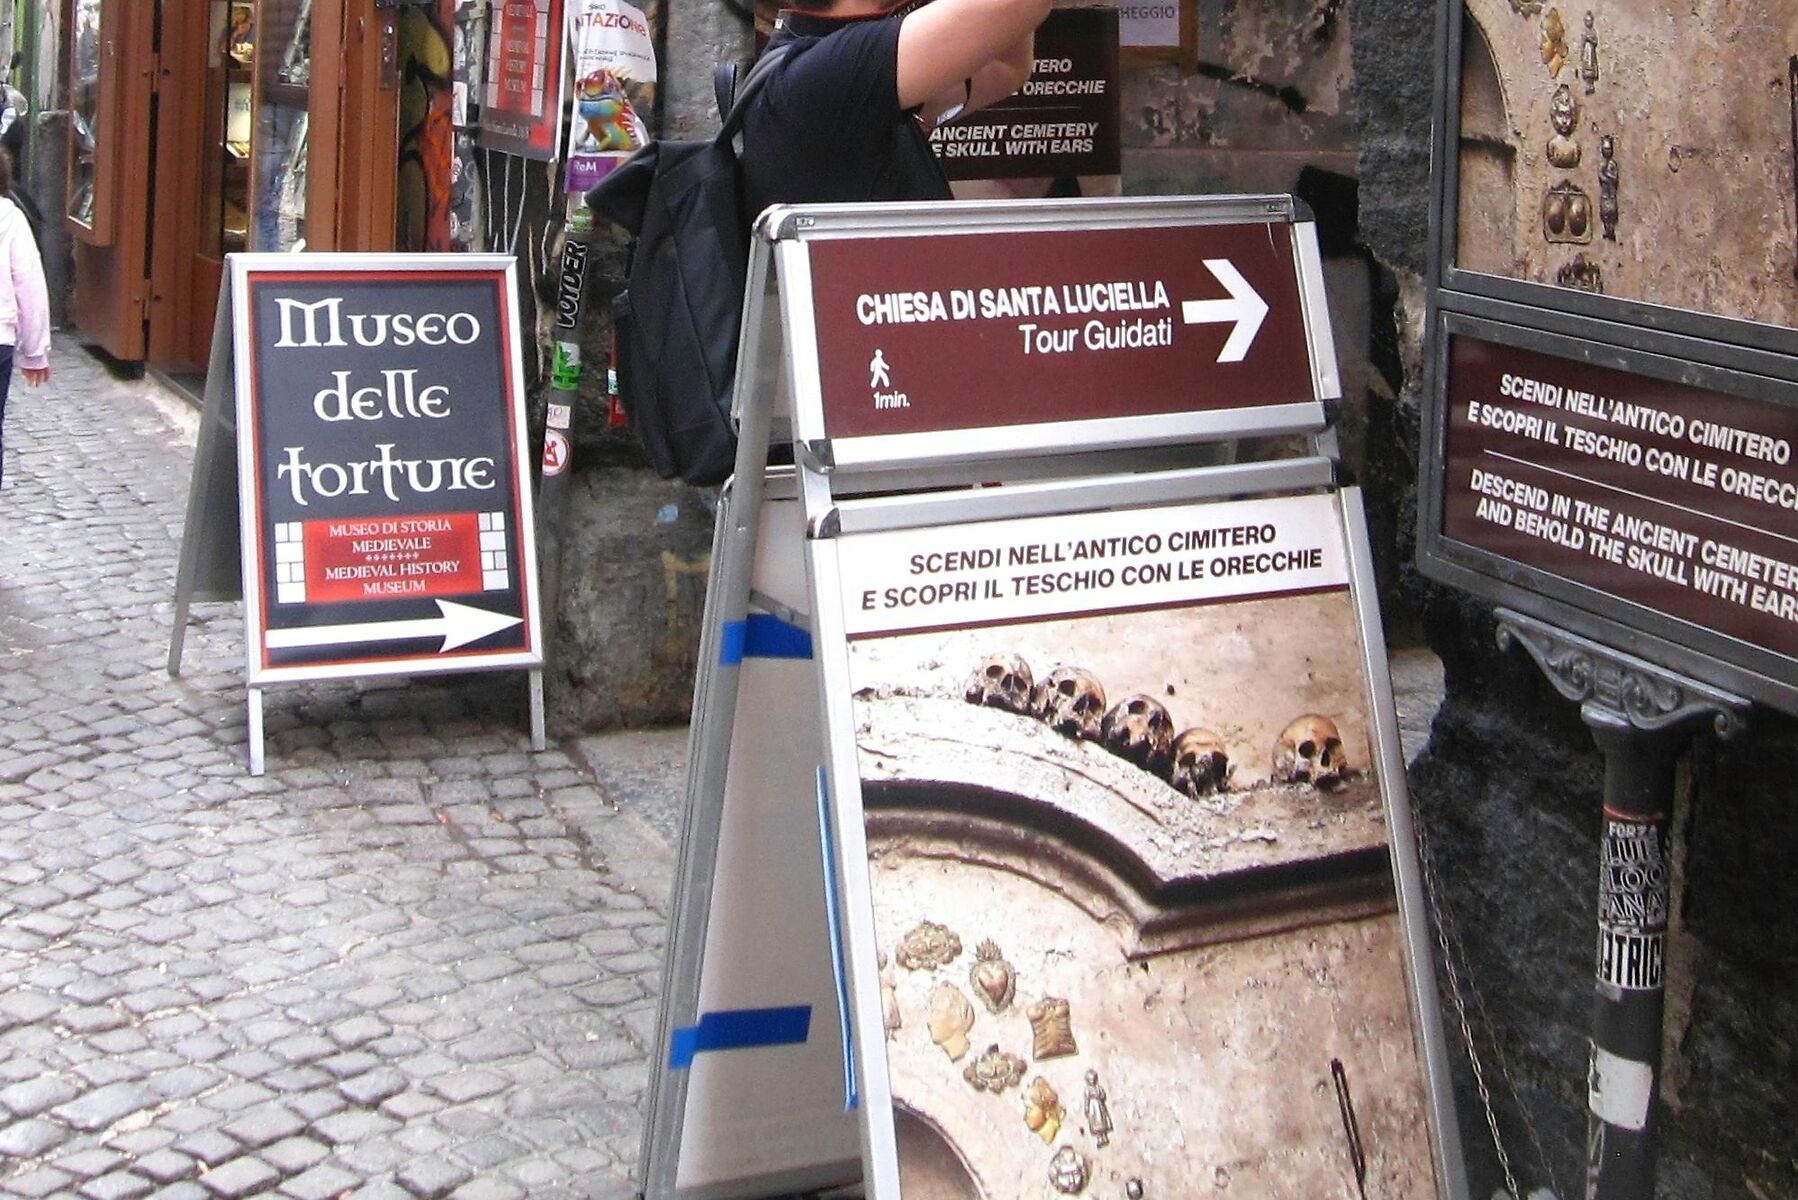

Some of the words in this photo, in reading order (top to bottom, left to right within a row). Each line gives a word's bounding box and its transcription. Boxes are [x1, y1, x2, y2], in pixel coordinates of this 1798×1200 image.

[1023, 80, 1106, 96] ORECCHIE
[928, 125, 1008, 142] ANCIENT
[1010, 122, 1099, 139] CEMETERY
[945, 141, 1000, 158] SKULL
[1005, 140, 1048, 156] WITH
[1050, 138, 1094, 154] EARS
[857, 291, 948, 326] CHIESA
[953, 289, 977, 319] DI
[981, 285, 1060, 319] SANTA
[1063, 280, 1170, 313] LUCIELLA
[1019, 323, 1078, 354] Tour
[1083, 316, 1172, 352] Guidati
[1500, 373, 1562, 407] SCENDI
[1565, 387, 1685, 440] NELL'ANTICO
[1688, 419, 1792, 466] CIMITERO
[1468, 400, 1479, 422] E
[1480, 403, 1542, 440] SCOPRI
[1544, 421, 1559, 445] IL
[1563, 425, 1643, 468] TESCHIO
[1644, 447, 1690, 481] CON
[1692, 459, 1718, 489] LE
[329, 521, 379, 536] MUSEO
[382, 520, 399, 535] DI
[401, 519, 452, 534] STORIA
[1470, 469, 1549, 512] DESCEND
[1551, 493, 1573, 520] IN
[1574, 500, 1610, 532] THE
[1611, 513, 1700, 560] ANCIENT
[352, 537, 432, 553] MEDIEVALE
[909, 547, 1002, 577] SCENDI
[1008, 533, 1162, 567] NELL'ANTICO
[1168, 524, 1277, 554] CIMITERO
[1475, 497, 1512, 527] AND
[1515, 508, 1585, 550] BEHOLD
[1588, 533, 1625, 564] THE
[1625, 544, 1688, 587] SKULL
[1693, 565, 1747, 606] WITH
[325, 563, 397, 580] MEDIEVAL
[400, 560, 461, 577] HISTORY
[363, 579, 426, 595] MUSEUM
[861, 590, 877, 611] E
[884, 580, 978, 610] SCOPRI
[983, 576, 1004, 600] IL
[1011, 568, 1116, 598] TESCHIO
[1121, 561, 1172, 588] CON
[1177, 557, 1205, 582] LE
[1210, 547, 1323, 579] ORECCHIE
